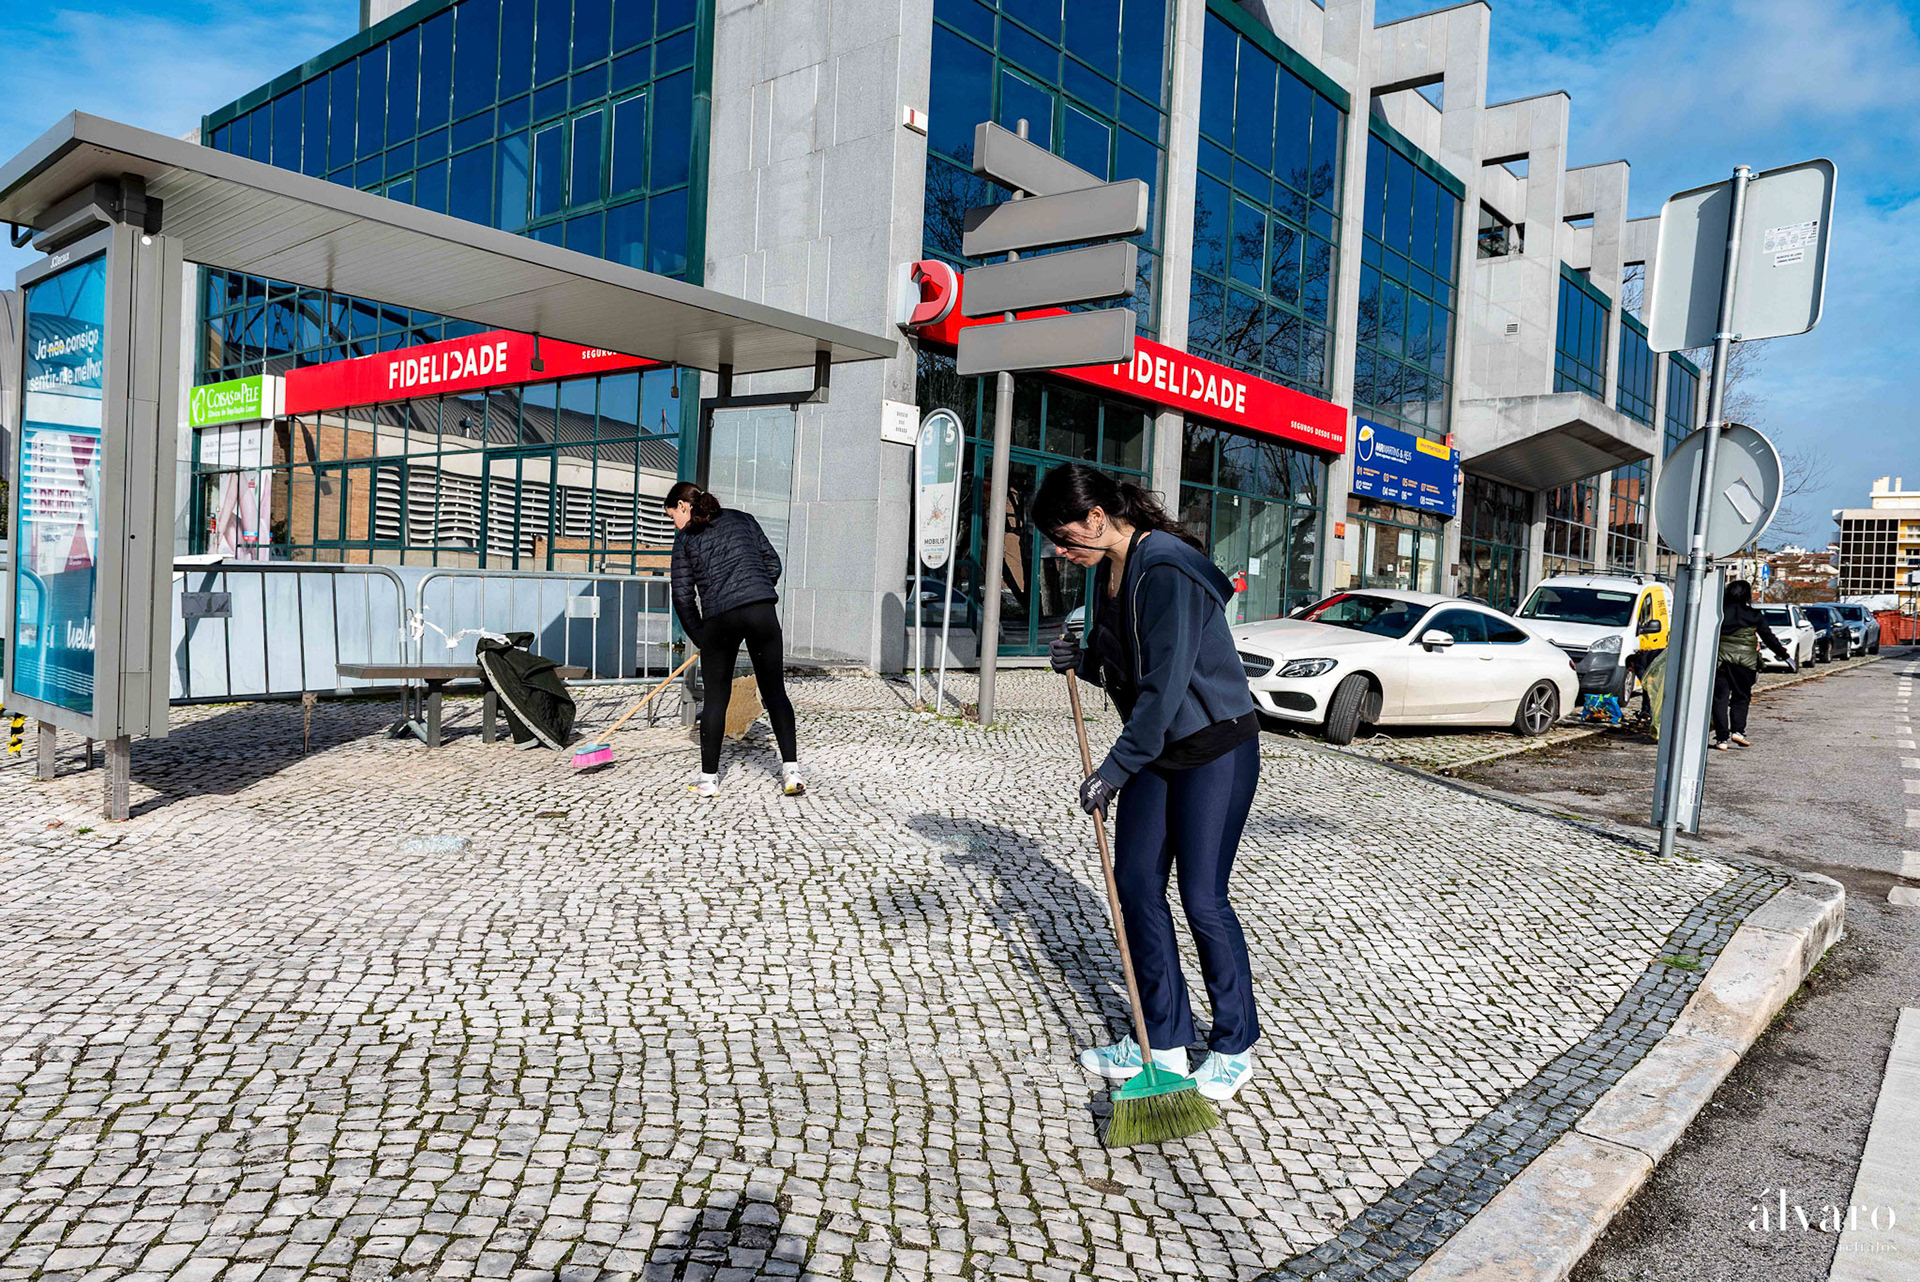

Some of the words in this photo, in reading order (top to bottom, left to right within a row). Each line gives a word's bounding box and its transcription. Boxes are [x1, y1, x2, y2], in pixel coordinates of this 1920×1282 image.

[34, 338, 47, 360] Já
[47, 335, 65, 358] não
[65, 324, 99, 353] consigo
[582, 348, 618, 360] SEGUR
[29, 366, 73, 392] sentir-me
[74, 357, 102, 383] melhor
[388, 341, 508, 390] FIDELIDADE
[206, 388, 234, 408] COISAS
[241, 382, 260, 404] PELE
[924, 425, 934, 446] 3
[944, 422, 956, 443] 5
[1290, 420, 1314, 434] SEGUROS
[1314, 428, 1330, 439] DESDE
[924, 537, 945, 545] MOBILIS
